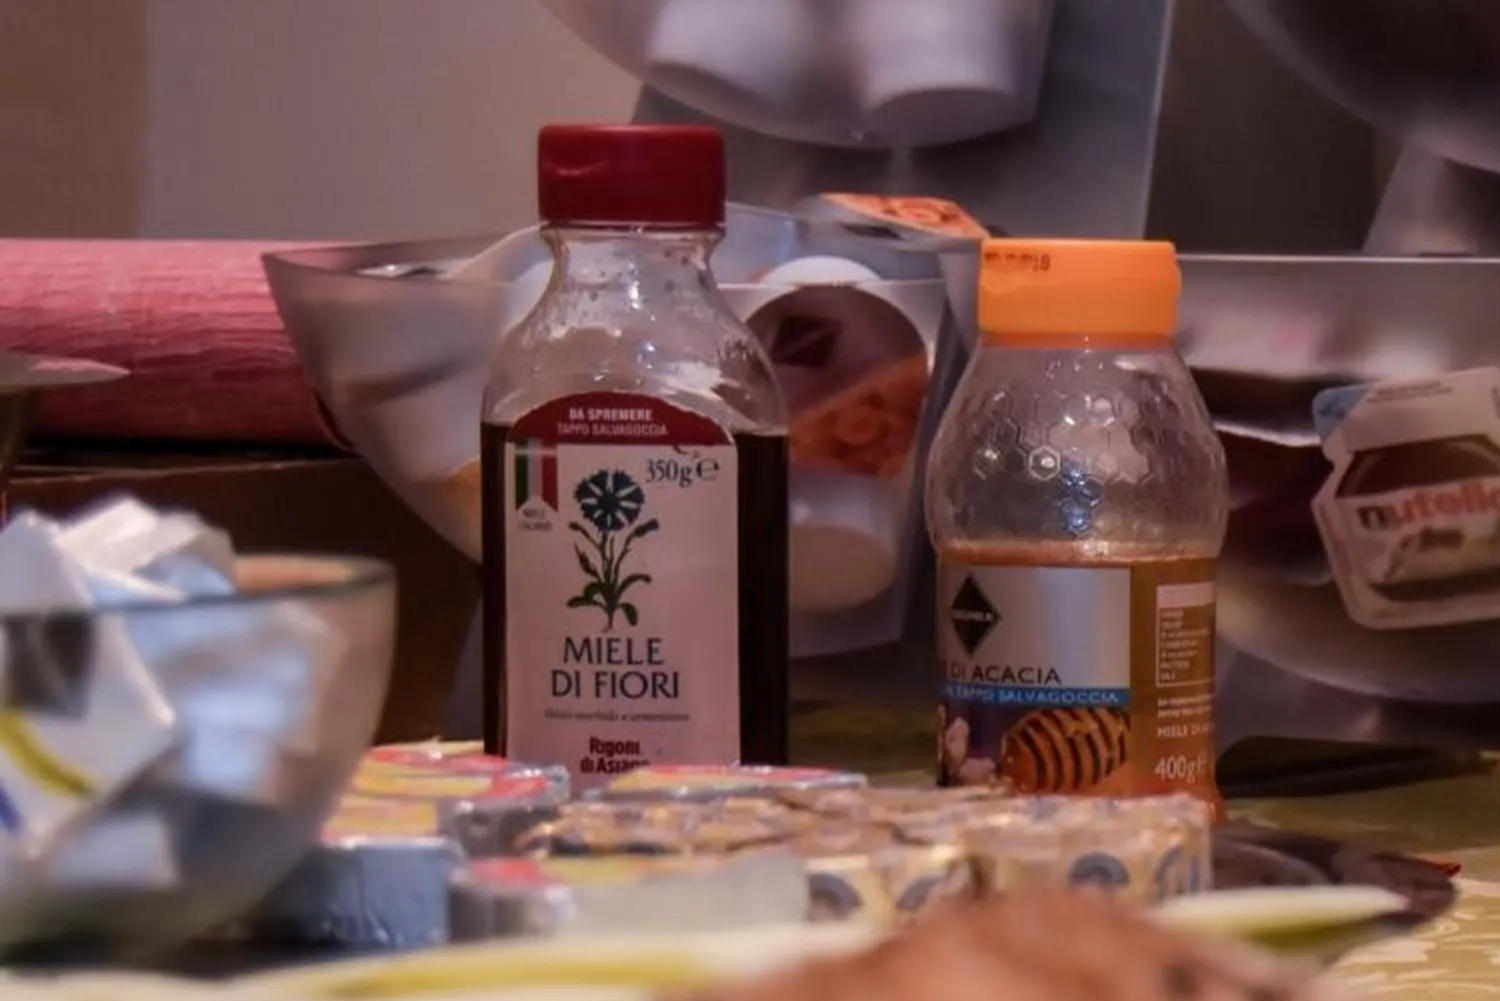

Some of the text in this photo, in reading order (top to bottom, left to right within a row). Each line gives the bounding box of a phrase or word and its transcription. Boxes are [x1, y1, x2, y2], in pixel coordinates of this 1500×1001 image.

[569, 408, 653, 422] DA SPREMERE
[557, 422, 668, 437] TAPPO SALVAGOCCIA
[562, 637, 665, 665] MIELE
[552, 670, 680, 699] DI FIORI
[972, 665, 1062, 687] ACACIA
[997, 687, 1119, 704] SALVAGOCCIA
[580, 755, 594, 773] di
